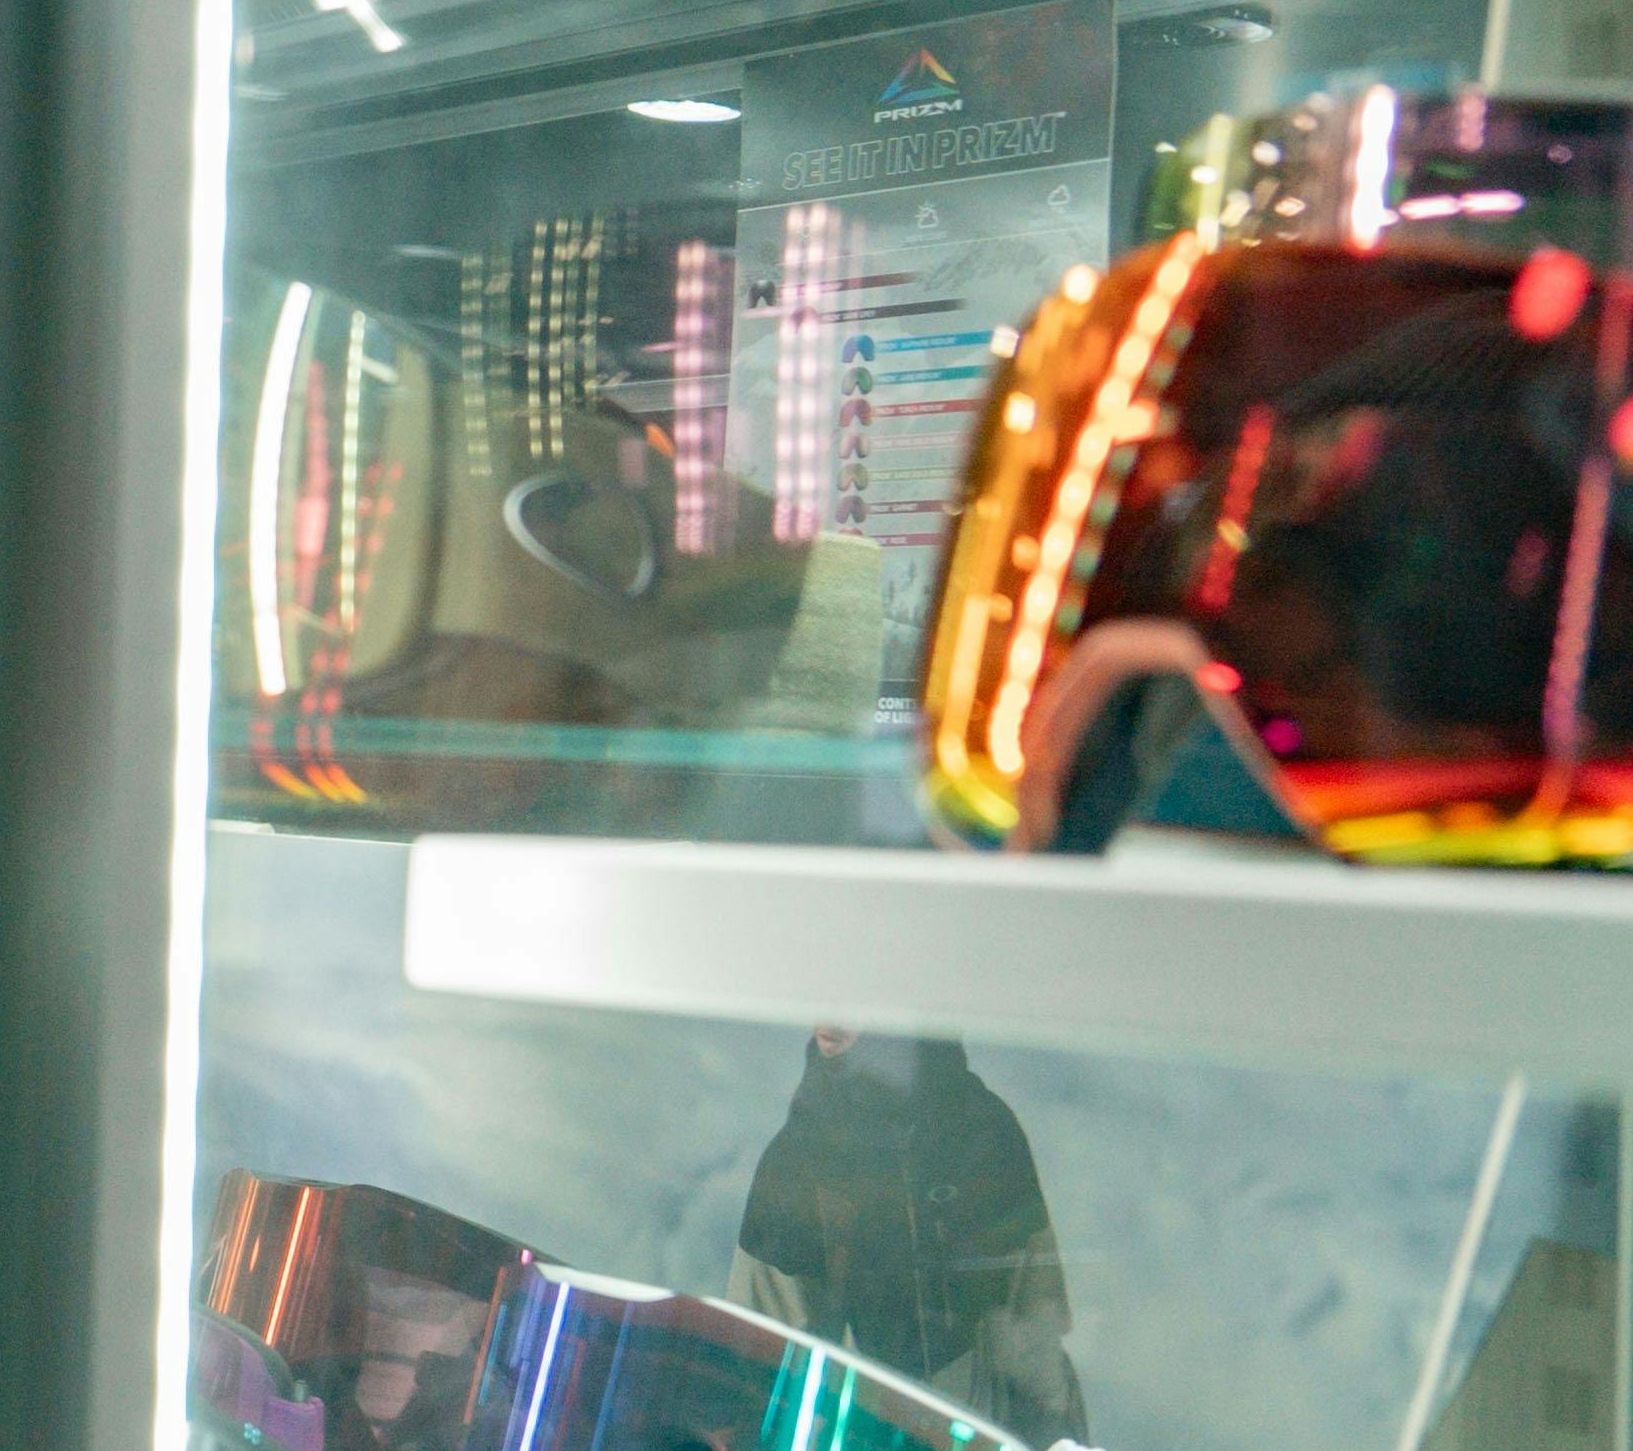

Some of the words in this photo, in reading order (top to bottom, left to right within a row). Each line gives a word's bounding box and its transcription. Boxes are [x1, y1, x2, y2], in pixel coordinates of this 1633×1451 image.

[781, 145, 844, 192] SEE
[845, 139, 887, 180] IT
[886, 132, 929, 176] IN
